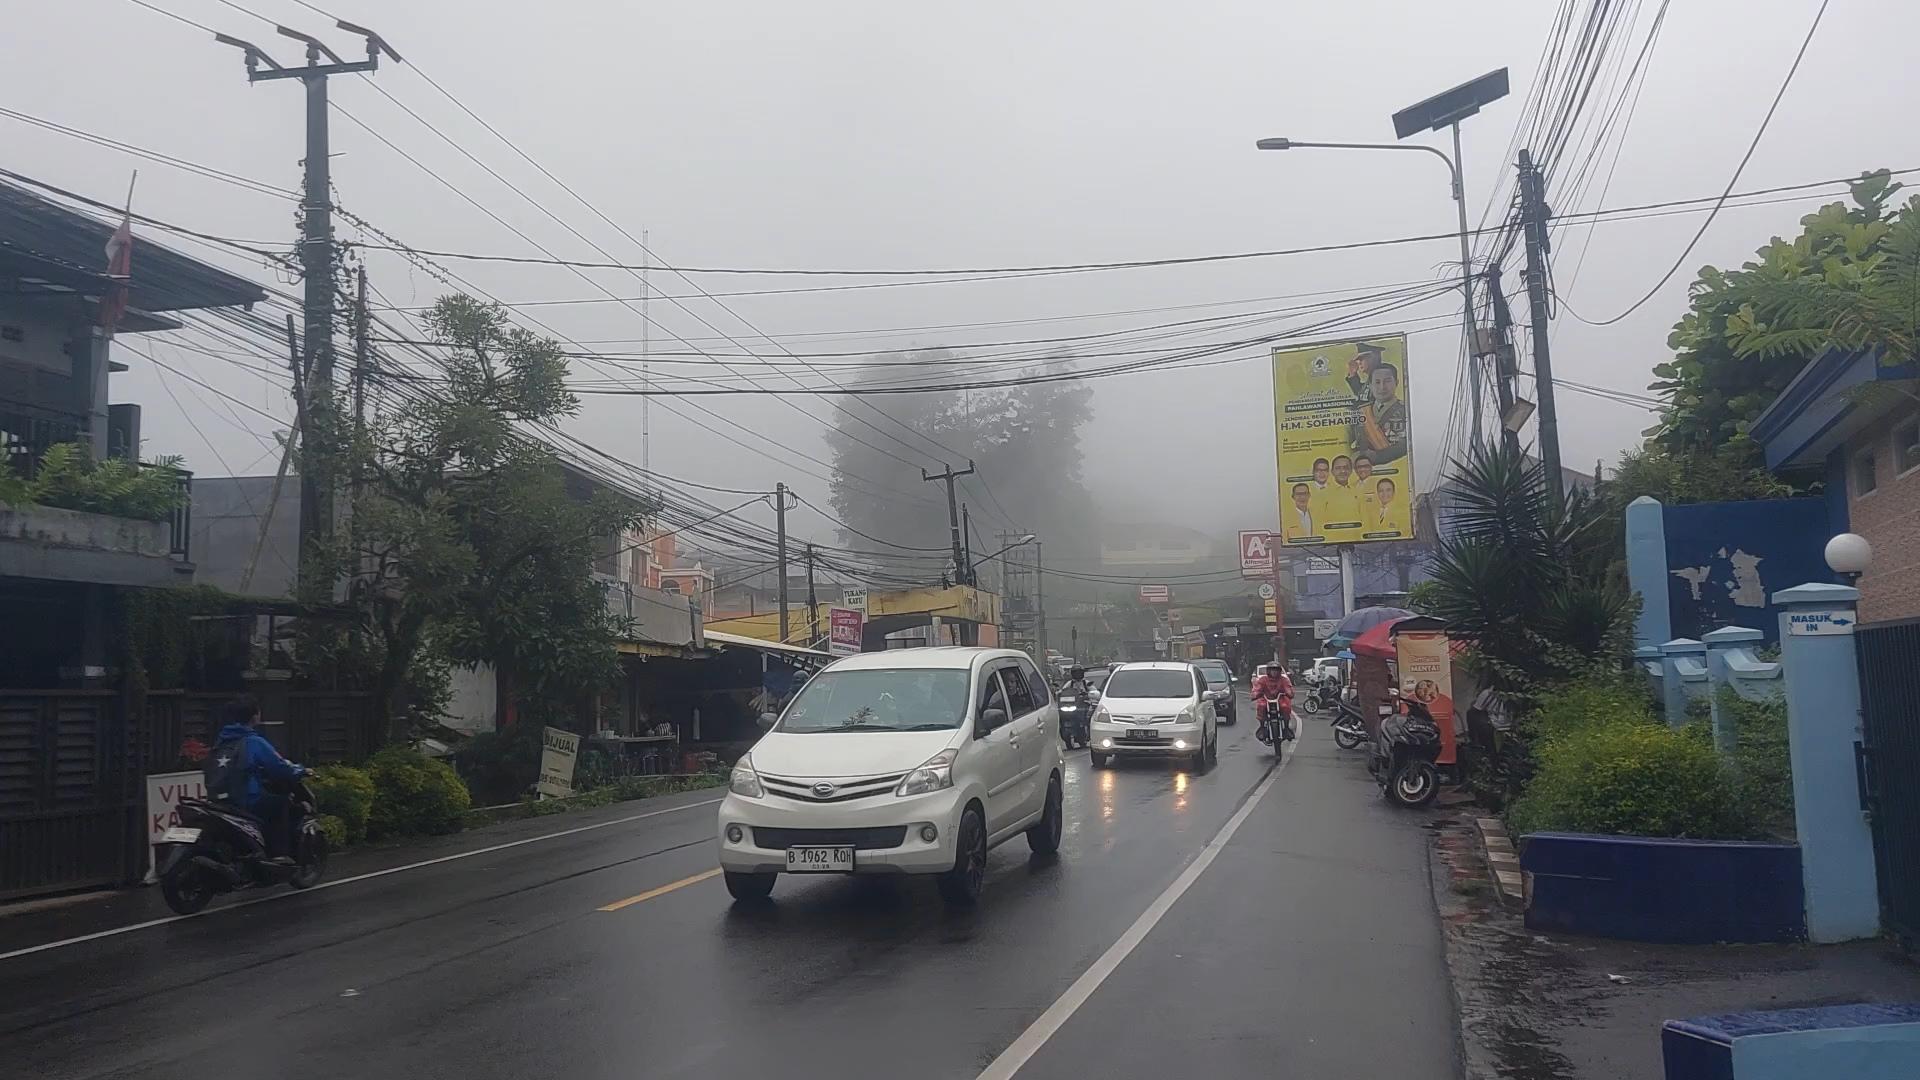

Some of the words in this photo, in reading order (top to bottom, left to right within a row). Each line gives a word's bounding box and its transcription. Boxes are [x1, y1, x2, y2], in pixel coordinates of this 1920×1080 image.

[1287, 403, 1322, 411] PAHLAWAN
[1322, 400, 1353, 409] NASIONAL
[1280, 422, 1304, 431] H.M.
[1306, 415, 1367, 429] SOEHARTO
[844, 589, 867, 598] TUKANG
[848, 597, 863, 605] KAYU
[1791, 614, 1832, 623] MASUK
[1806, 623, 1818, 631] IN
[543, 728, 576, 754] DIJUAL
[159, 783, 207, 803] VILL
[153, 811, 181, 833] KA
[788, 850, 796, 864] B
[800, 850, 828, 863] 1962
